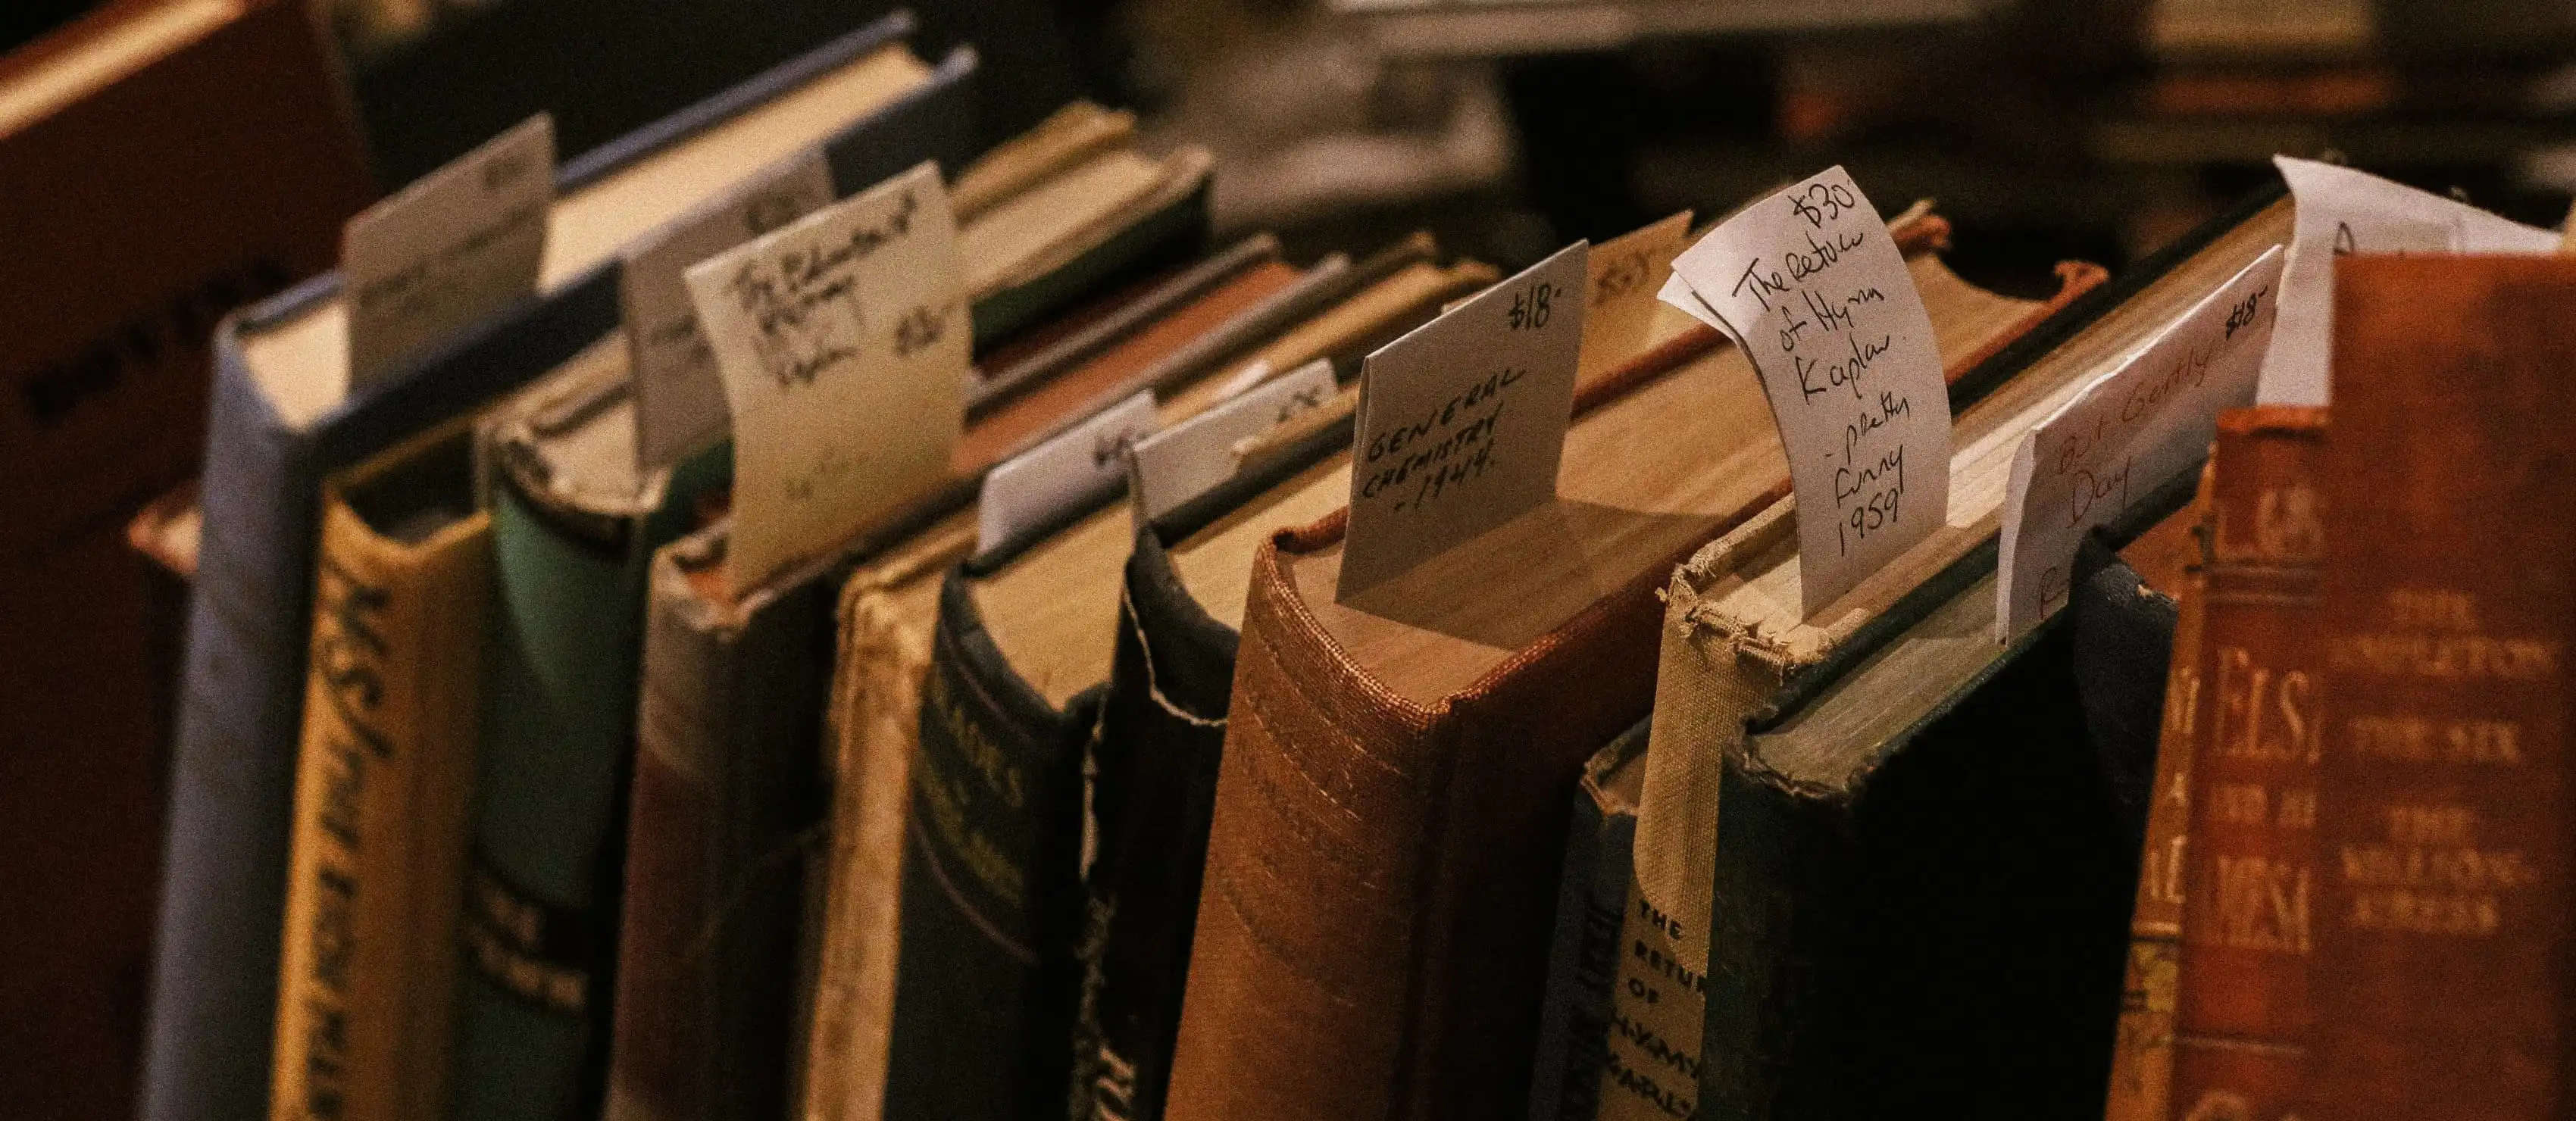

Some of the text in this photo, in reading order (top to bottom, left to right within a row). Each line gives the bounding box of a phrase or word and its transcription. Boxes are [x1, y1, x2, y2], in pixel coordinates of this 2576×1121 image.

[1733, 258, 1790, 312] The
[1780, 306, 1808, 352] of
[1368, 367, 1527, 464] GENERAL
[1363, 399, 1505, 498] CHEMISTRY
[1839, 487, 1898, 557] 1959
[1640, 898, 1682, 941] THE
[1628, 978, 1659, 1005] OF
